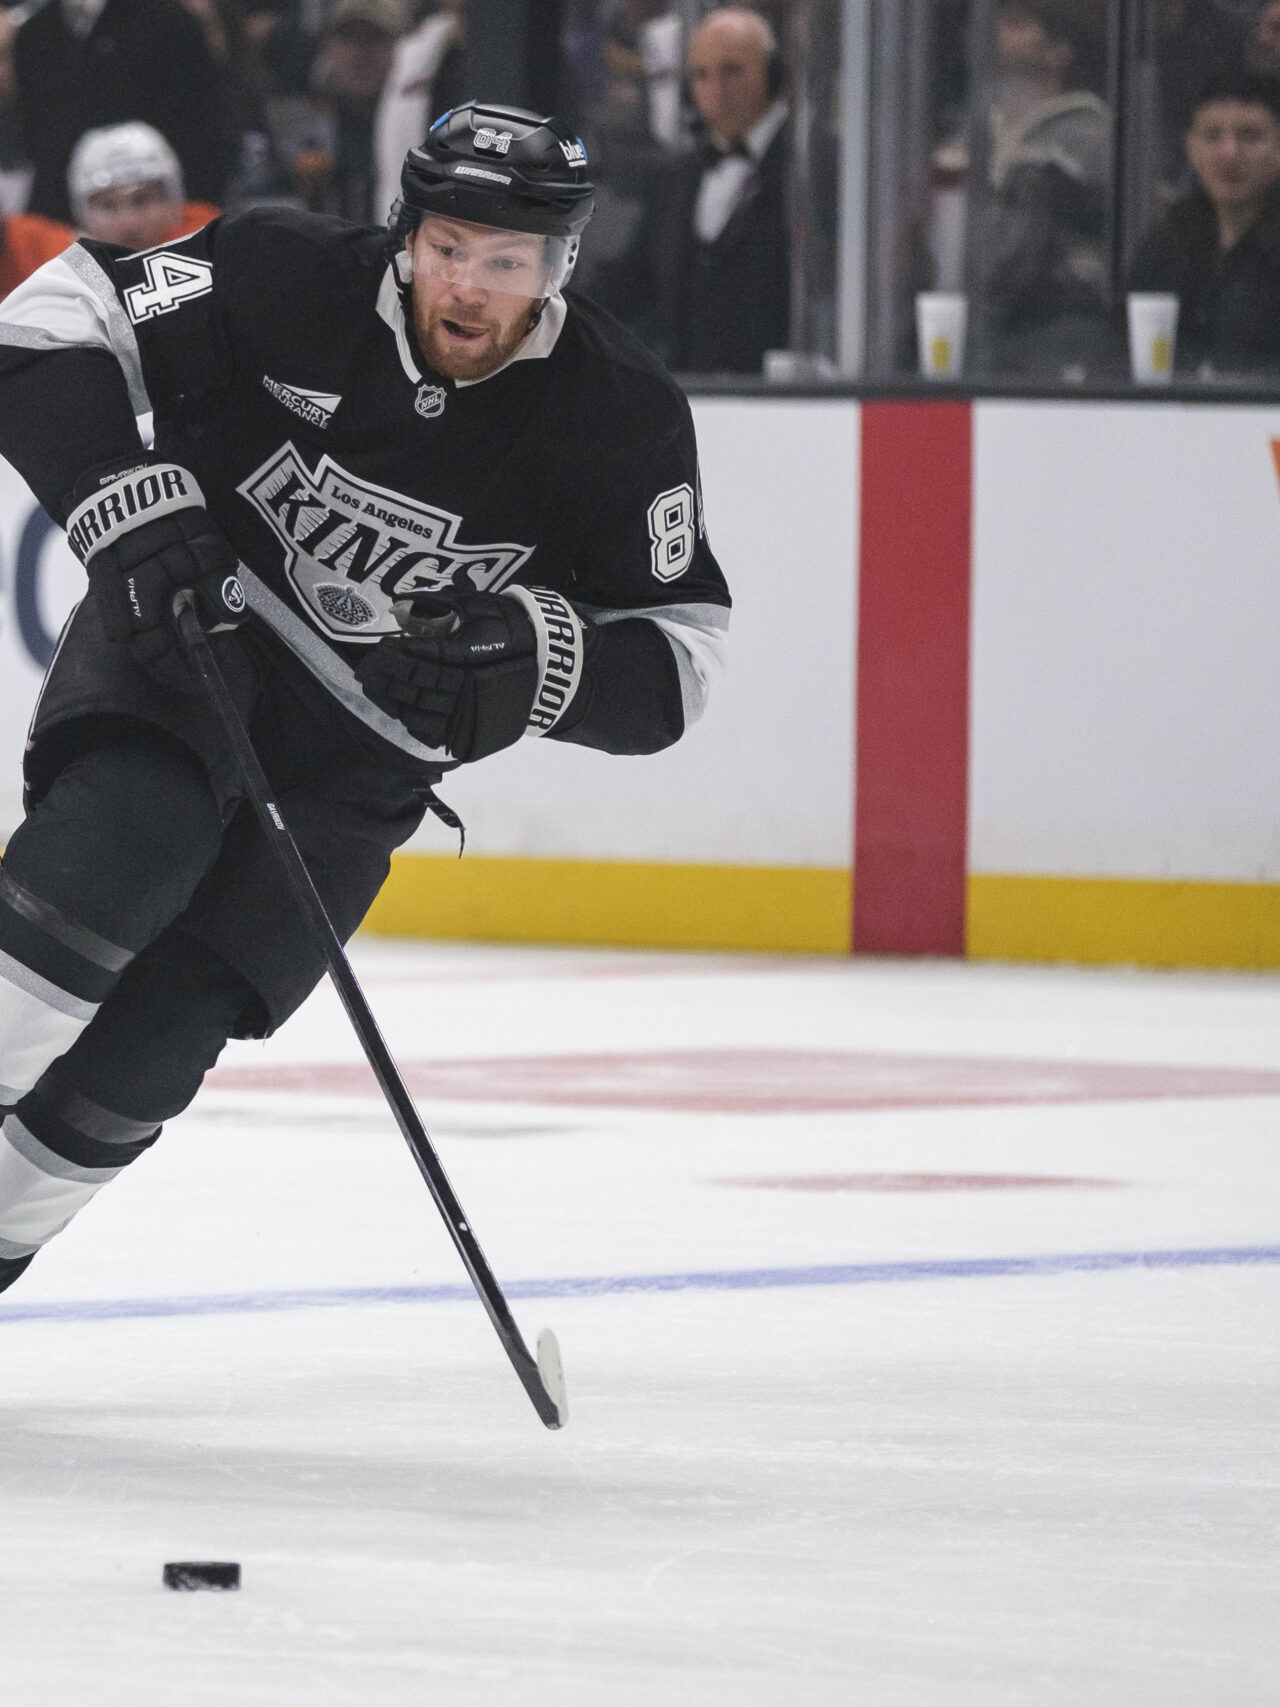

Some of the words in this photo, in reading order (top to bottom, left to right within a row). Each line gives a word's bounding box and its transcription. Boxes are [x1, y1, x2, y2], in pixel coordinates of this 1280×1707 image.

[473, 128, 513, 154] 84
[122, 248, 214, 326] 4
[263, 375, 331, 422] MERCURY
[263, 383, 328, 429] NSURANCE
[421, 395, 440, 410] NHL
[265, 471, 502, 596] KINGS
[331, 485, 360, 509] Los
[362, 502, 433, 539] Angeles
[647, 482, 705, 583] 8
[128, 577, 141, 617] ALPHA
